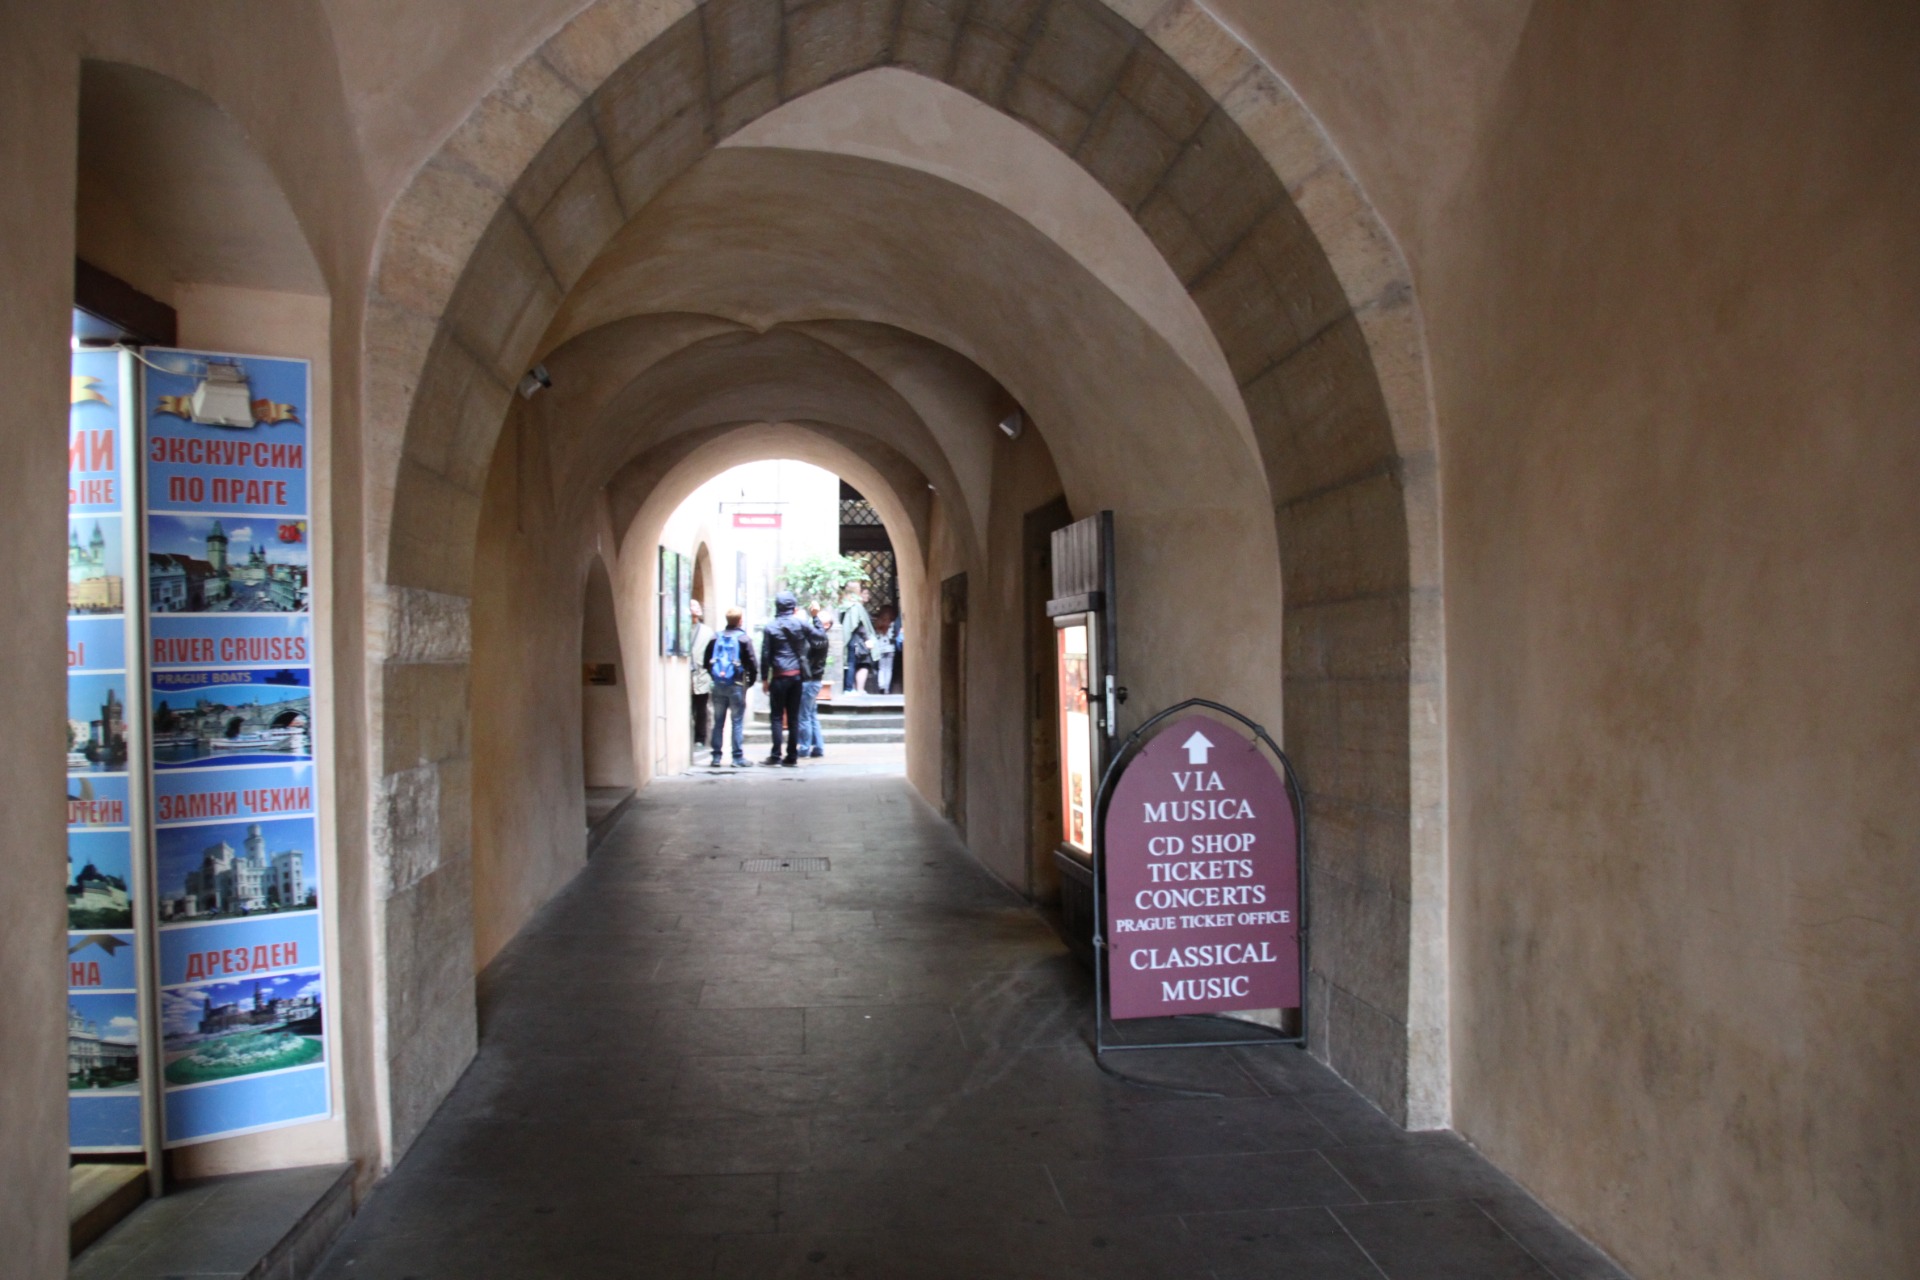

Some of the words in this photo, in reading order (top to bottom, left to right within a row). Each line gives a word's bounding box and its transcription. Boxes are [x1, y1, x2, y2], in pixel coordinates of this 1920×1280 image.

[151, 437, 303, 468] ЭКСКУРСИИ
[169, 476, 204, 502] ПО
[212, 478, 287, 505] ПРАГЕ
[154, 638, 214, 662] RIVER
[221, 637, 306, 661] CRUISES
[157, 673, 208, 684] PRAGUE
[212, 672, 252, 683] BOATS
[1172, 771, 1225, 792] VIA
[159, 792, 237, 820] ЗАМКИ
[243, 787, 310, 813] ЧЕХИИ
[1143, 798, 1256, 823] MUSICA
[1148, 836, 1184, 856] CD
[1191, 833, 1256, 855] SHOP
[1147, 859, 1254, 882] TICKETS
[1135, 885, 1266, 910] CONCERTS
[1116, 916, 1176, 932] PRAGUE
[1179, 913, 1236, 930] TICKET
[1237, 911, 1290, 926] OFFICE
[186, 942, 298, 982] ДРЕЗДЕН
[1129, 942, 1277, 971] CLASSICAL
[70, 962, 100, 986] НА
[1161, 976, 1249, 1002] MUSIC
